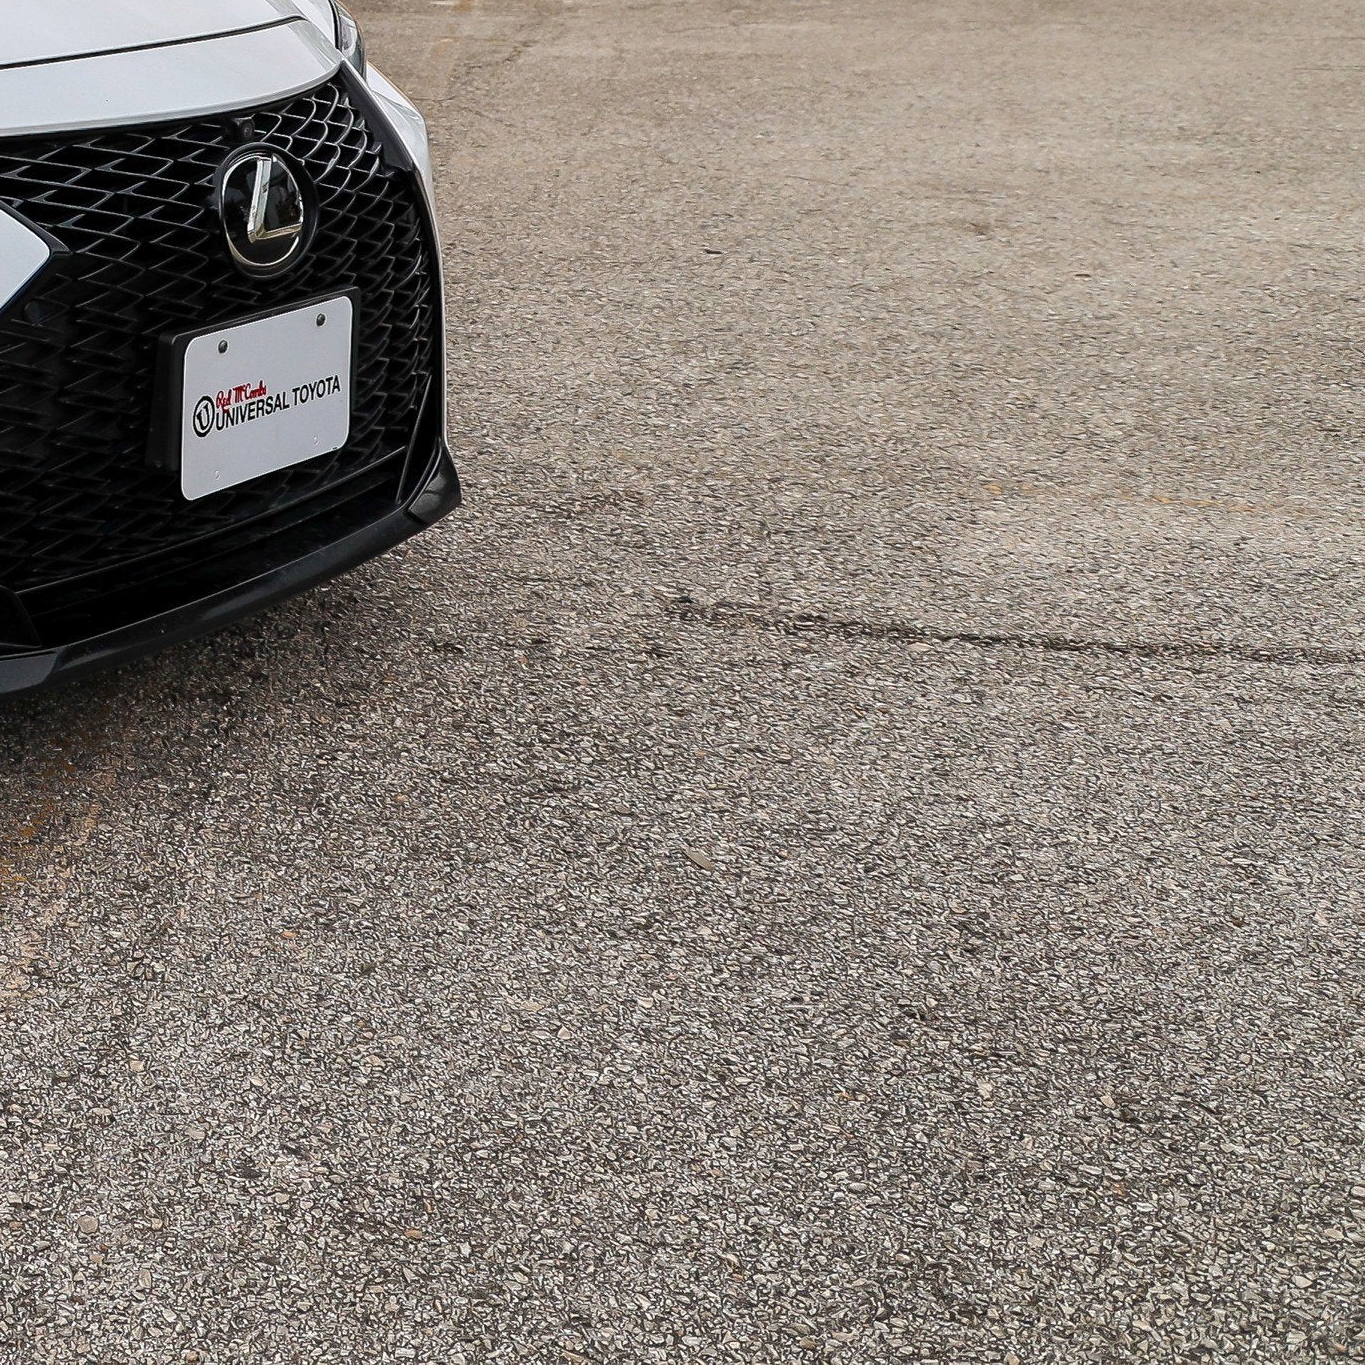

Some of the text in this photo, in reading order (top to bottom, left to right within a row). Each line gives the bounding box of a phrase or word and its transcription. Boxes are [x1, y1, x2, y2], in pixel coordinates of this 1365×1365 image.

[215, 389, 232, 413] Red
[215, 374, 341, 431] UNIVERSAL TOYOTA
